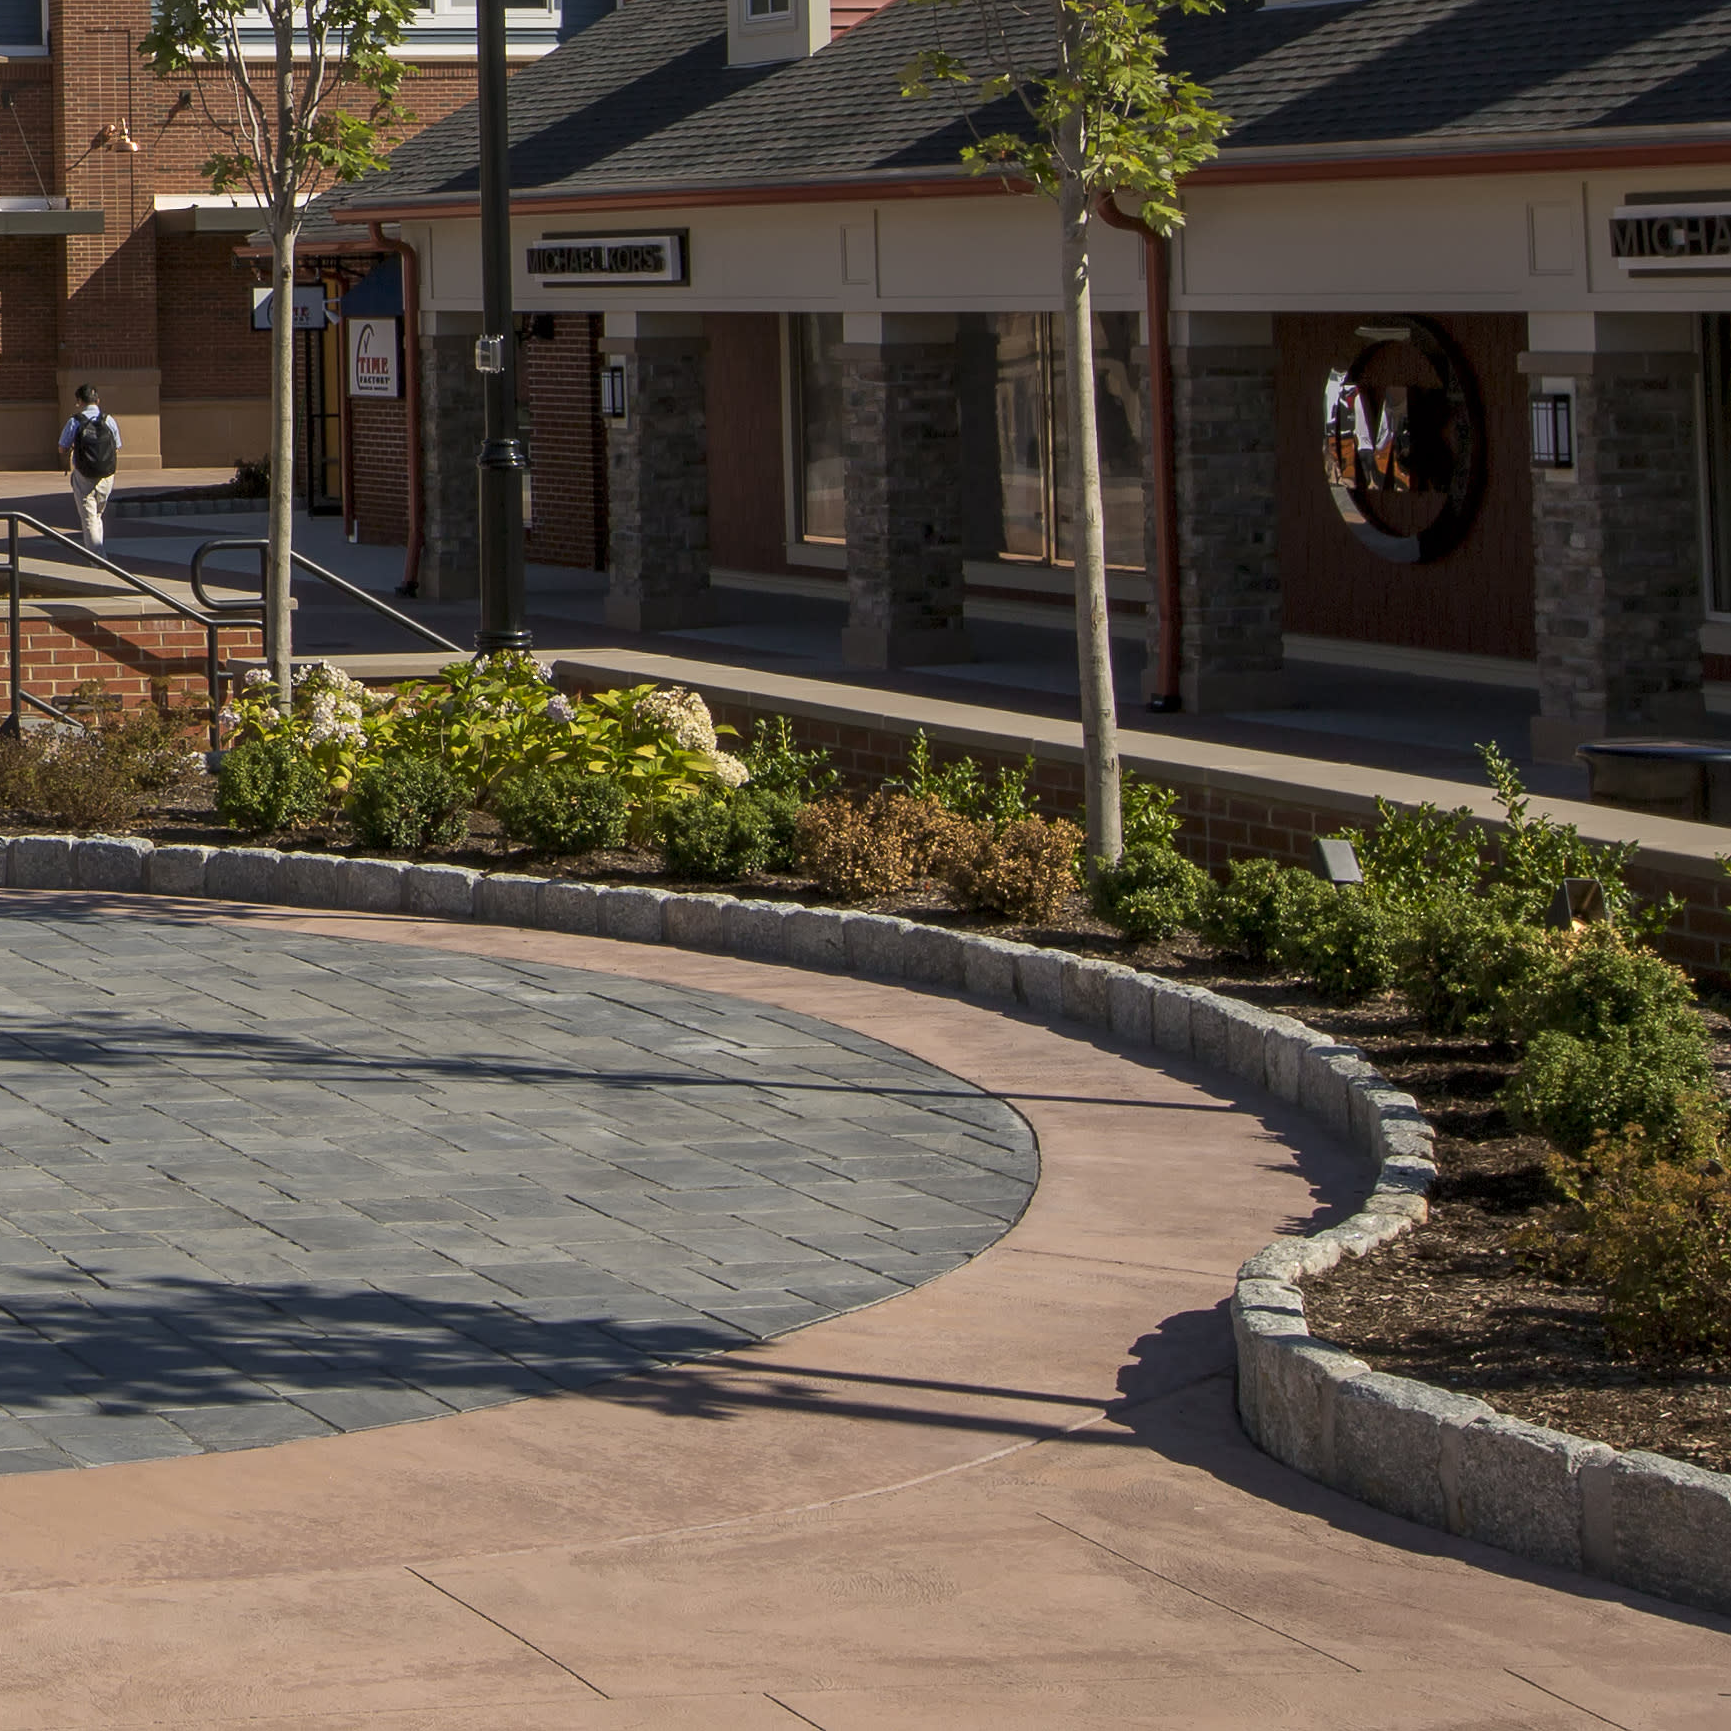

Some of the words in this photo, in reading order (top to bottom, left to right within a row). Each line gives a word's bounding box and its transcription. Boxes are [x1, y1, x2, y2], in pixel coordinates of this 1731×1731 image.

[527, 247, 607, 274] MICHAEL
[607, 245, 665, 274] KORS
[358, 356, 389, 375] TIME
